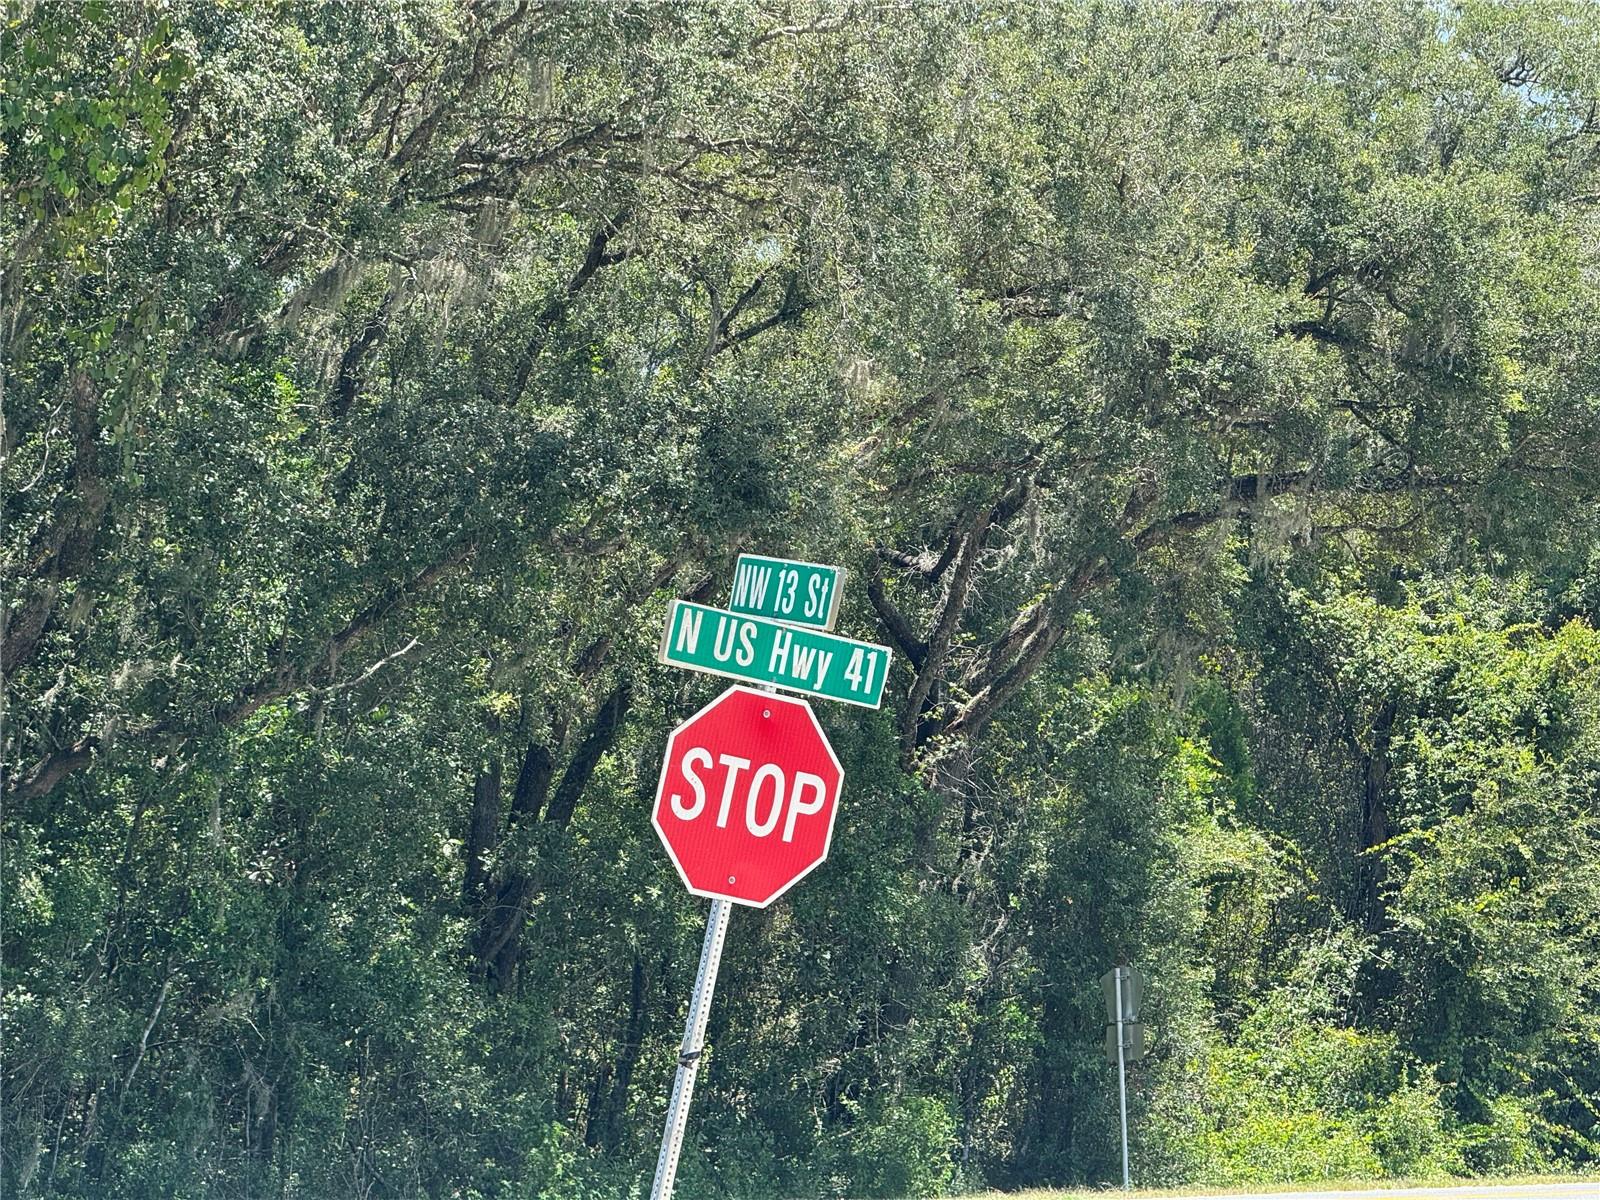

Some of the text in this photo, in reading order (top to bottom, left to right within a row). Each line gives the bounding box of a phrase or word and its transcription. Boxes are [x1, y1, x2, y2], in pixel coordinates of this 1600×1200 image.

[733, 563, 829, 619] NW 13 St
[675, 607, 878, 695] N US Hwy 41
[670, 747, 827, 843] STOP
